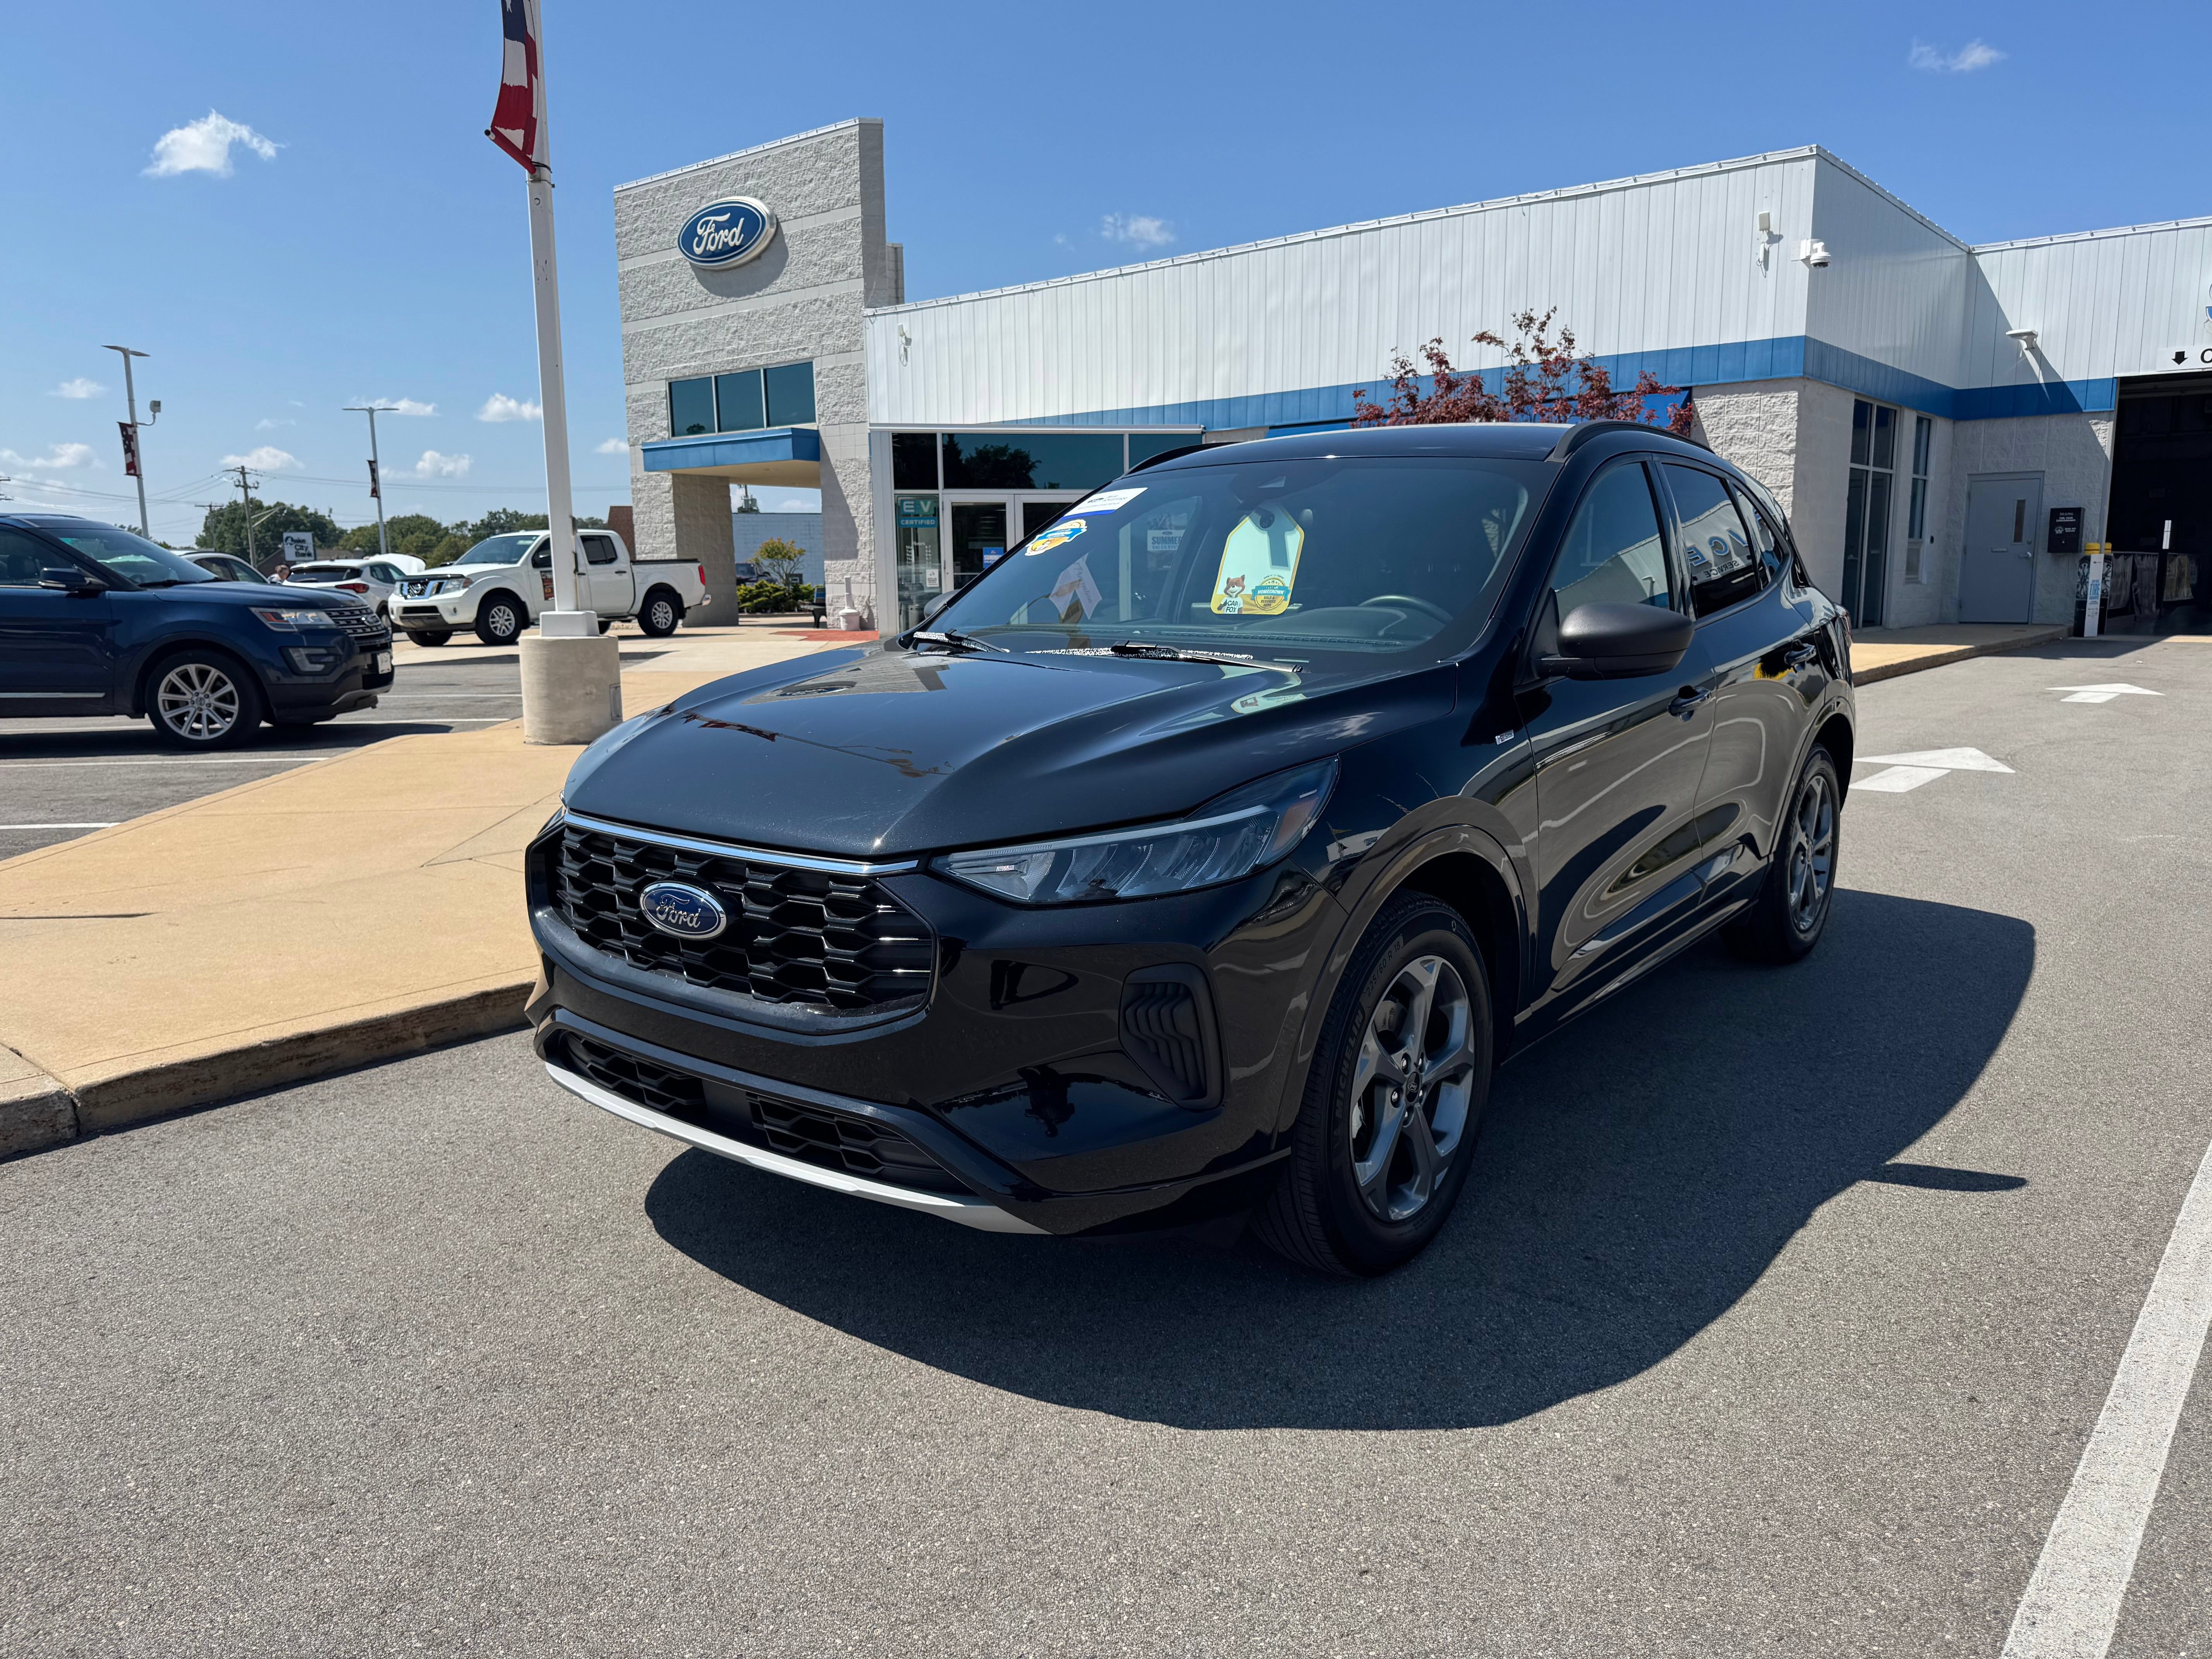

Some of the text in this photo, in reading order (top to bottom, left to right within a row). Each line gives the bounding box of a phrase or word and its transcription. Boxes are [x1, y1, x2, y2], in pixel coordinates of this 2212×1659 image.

[693, 213, 744, 255] Ford
[903, 501, 932, 513] EV
[656, 894, 702, 928] Ford
[1367, 941, 1400, 997] 225/60 R 18
[1335, 1010, 1364, 1119] MICHELIN
